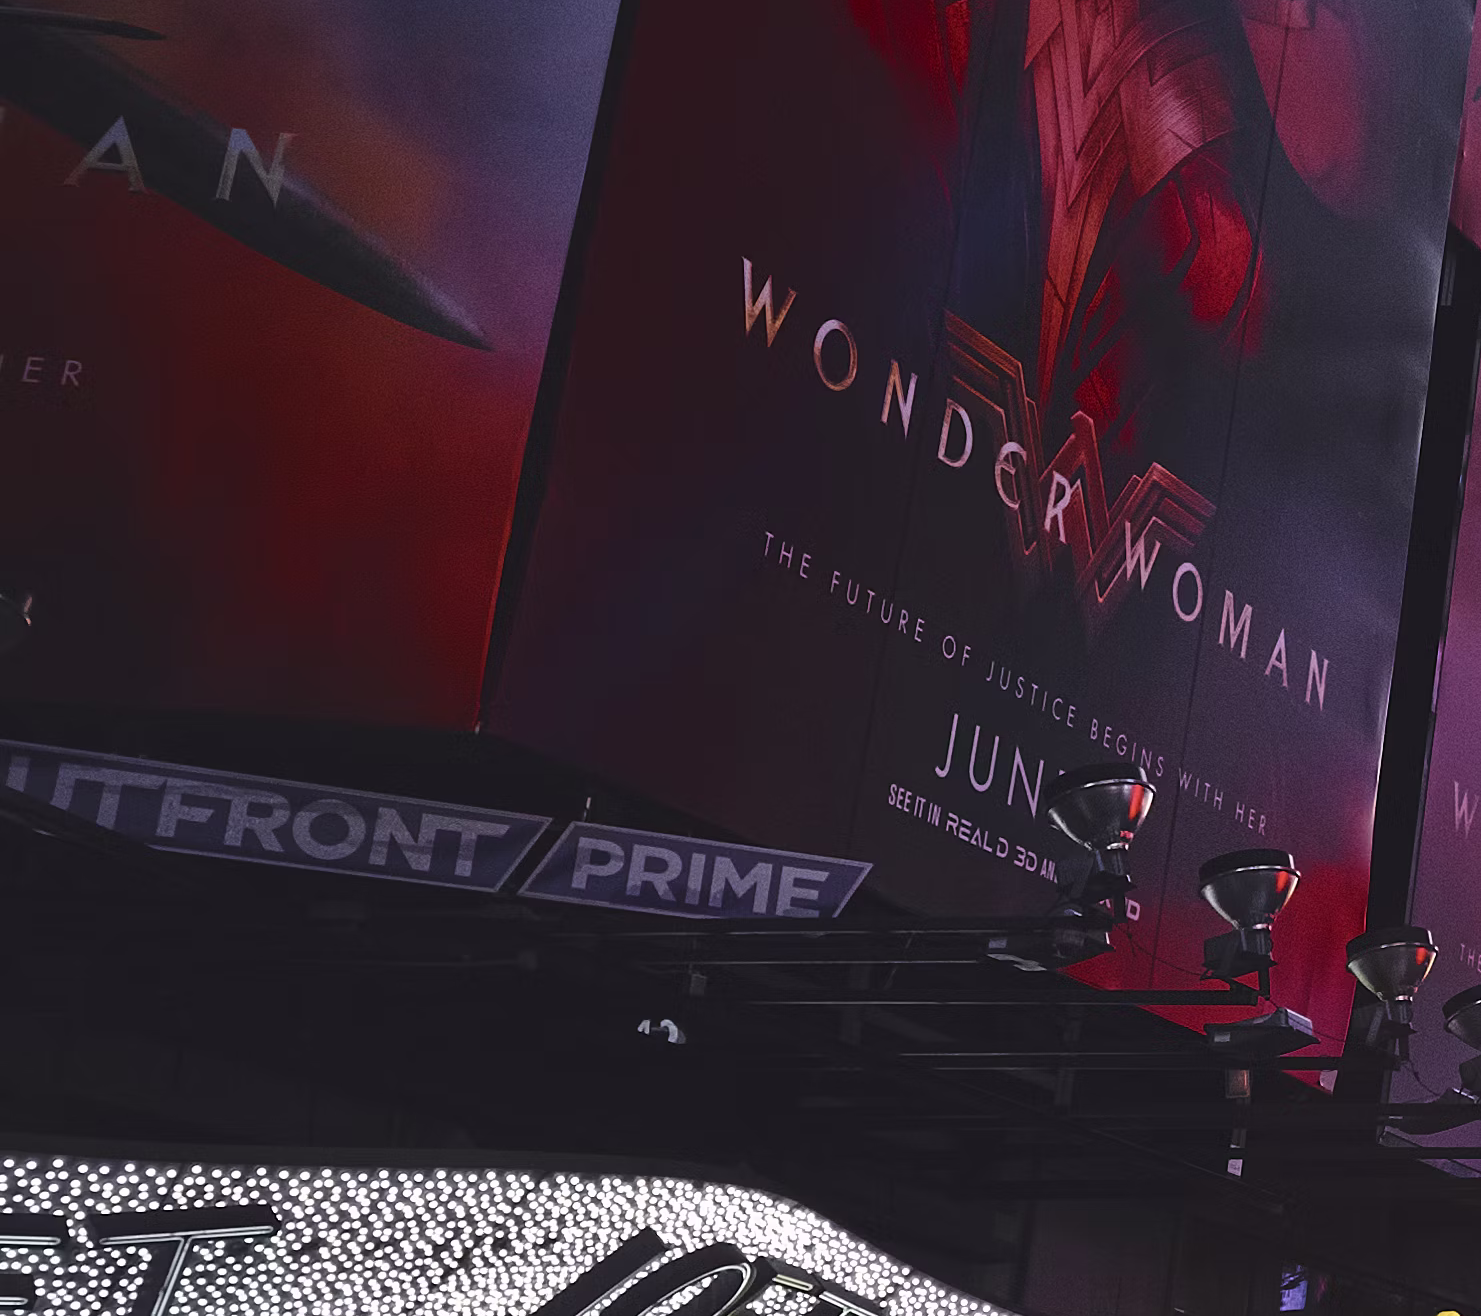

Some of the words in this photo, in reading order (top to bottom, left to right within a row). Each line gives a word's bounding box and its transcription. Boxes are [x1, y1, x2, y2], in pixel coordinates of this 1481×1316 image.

[741, 256, 1083, 544] WONDER
[1124, 521, 1329, 711] WOMAN
[765, 532, 811, 579] THE
[830, 570, 924, 644] FUTURE
[942, 635, 972, 668] OF
[986, 660, 1077, 728] JUSTICE
[1090, 717, 1166, 777] BEGINS
[1178, 767, 1224, 813] WITH
[1235, 798, 1267, 836] HER
[934, 713, 1064, 820] JUN
[571, 837, 830, 920] PRIME
[888, 783, 912, 813] SEE
[914, 795, 927, 818] IT
[928, 802, 942, 827] IN
[1013, 845, 1037, 872] 3D
[1040, 859, 1057, 883] AN
